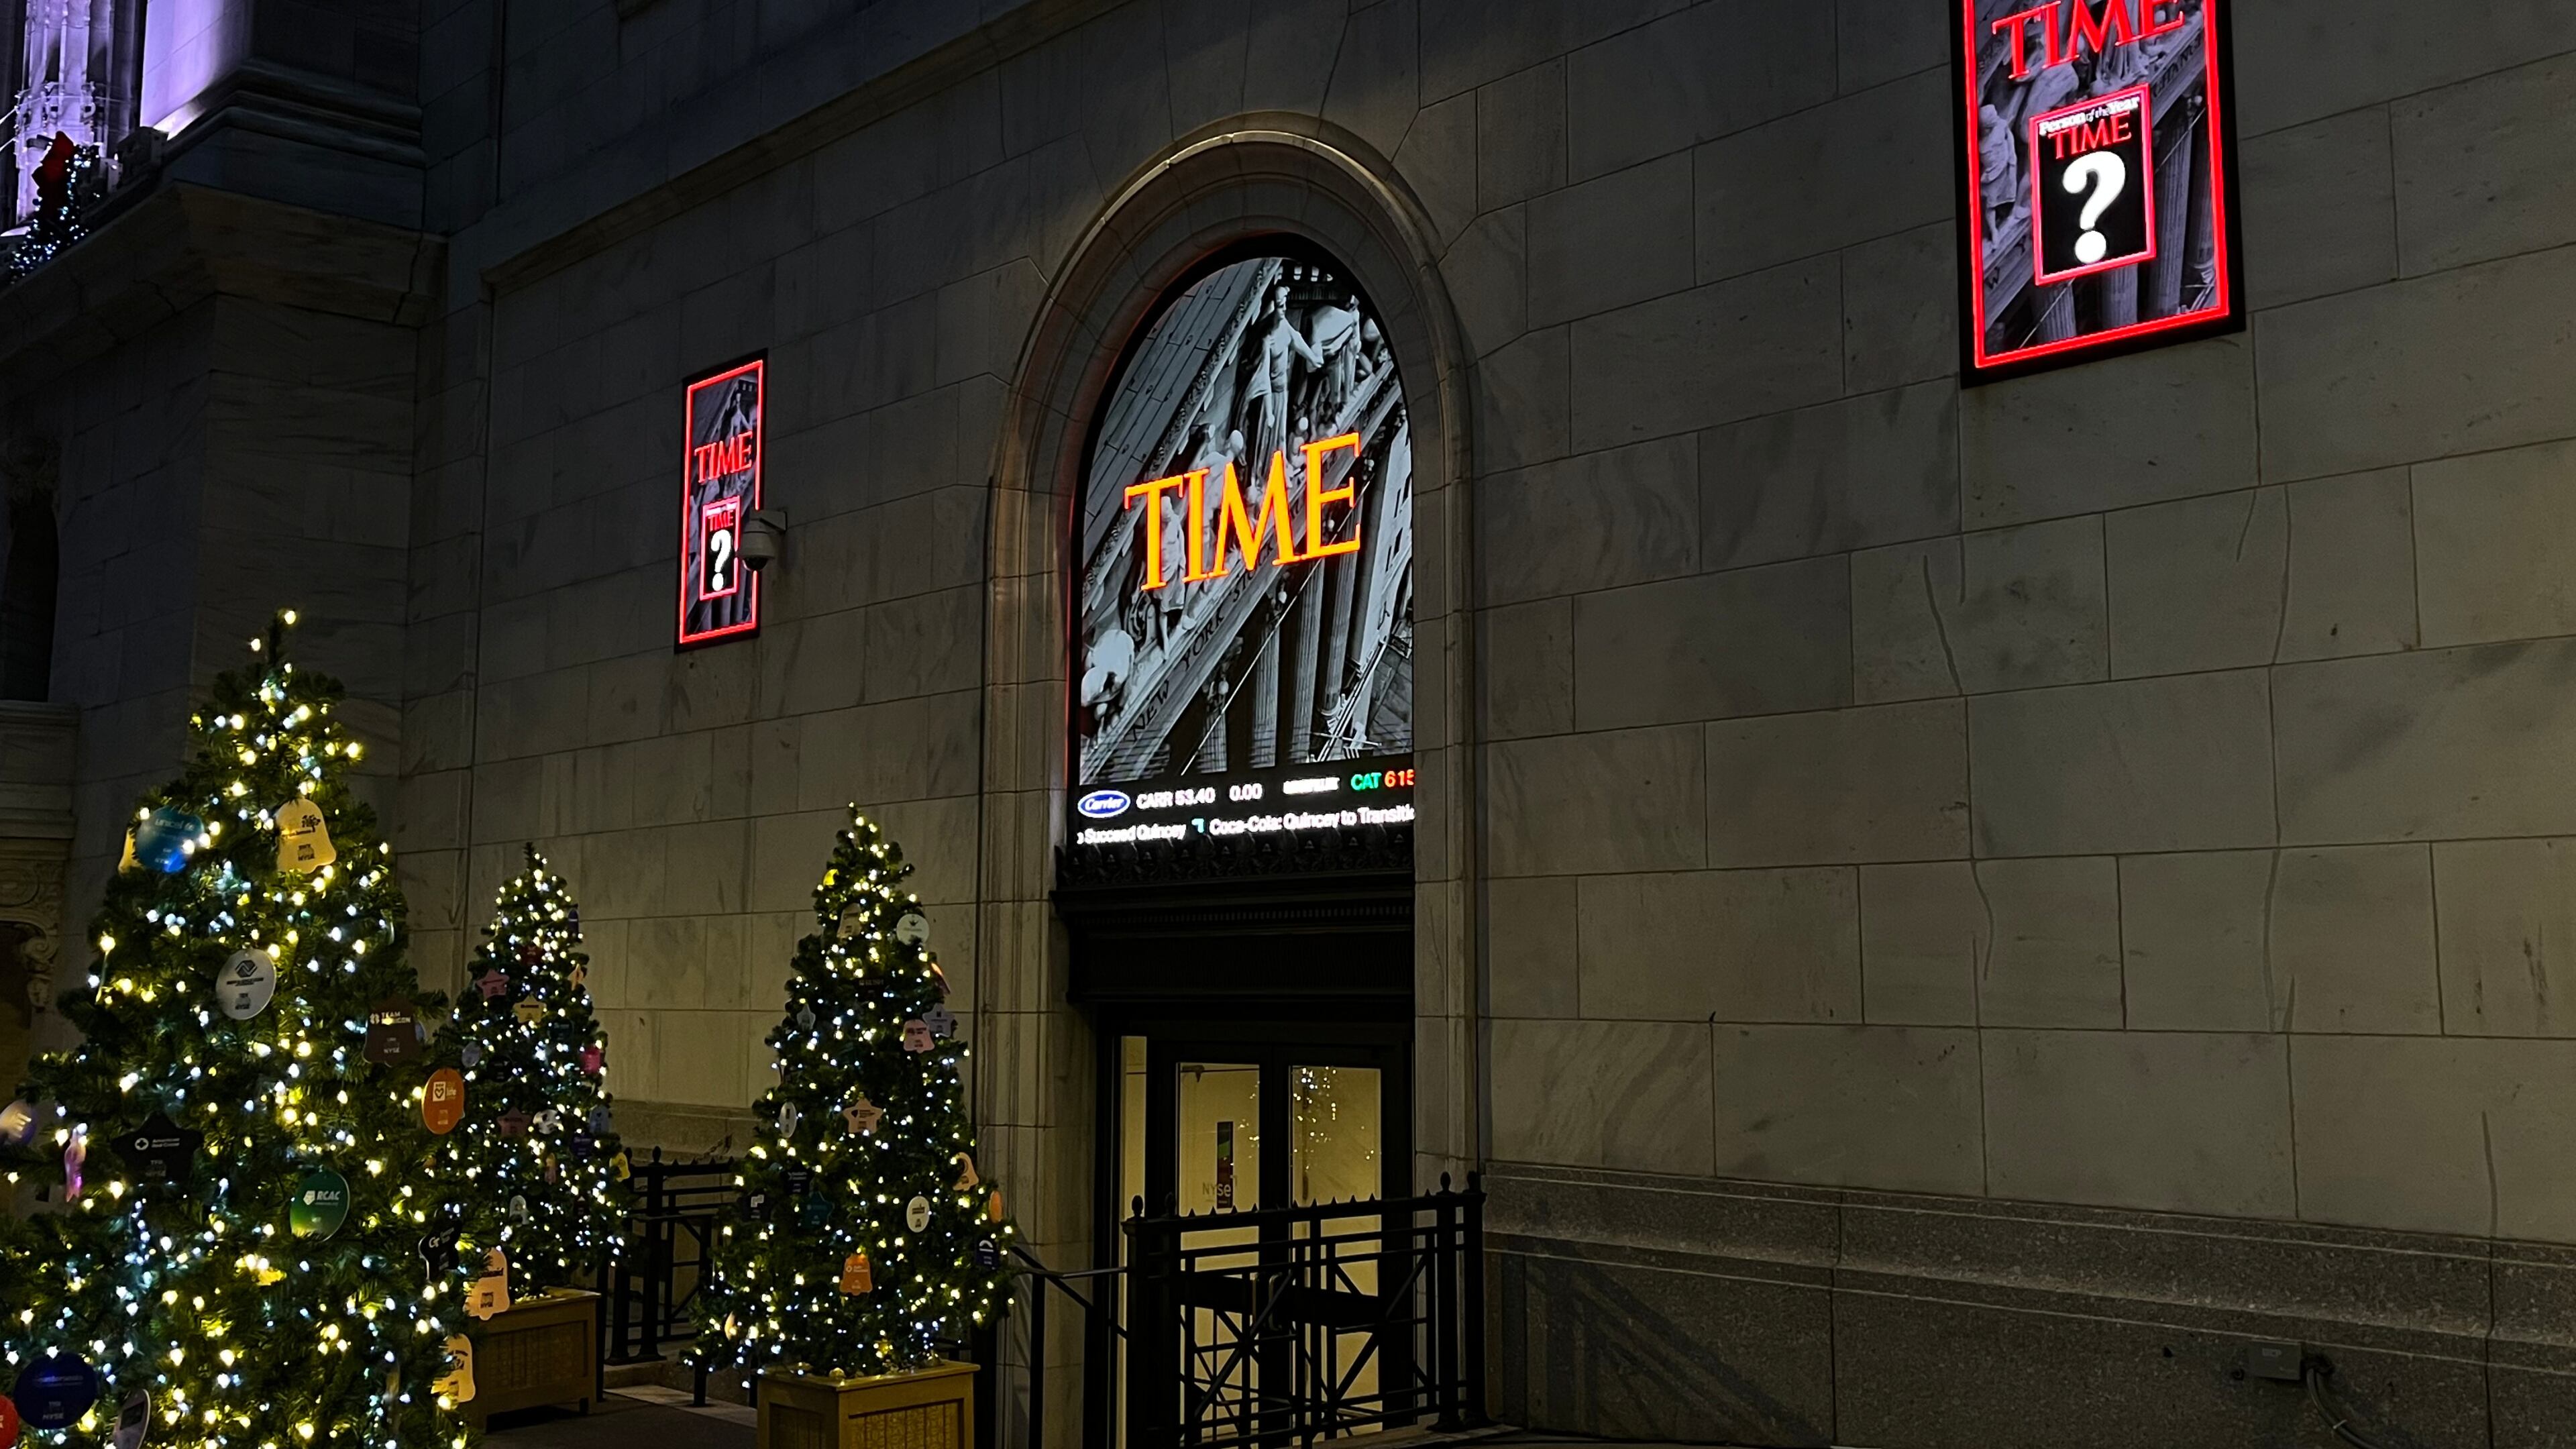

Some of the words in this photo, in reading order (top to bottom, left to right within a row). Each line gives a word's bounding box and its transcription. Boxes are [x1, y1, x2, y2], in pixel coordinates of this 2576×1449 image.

[2048, 110, 2132, 160] TIME
[694, 430, 753, 483] TIME
[708, 509, 734, 532] TIME
[1124, 431, 1361, 591] TIME
[1136, 791, 1173, 809] CARR
[1175, 787, 1216, 806] 53.40
[1229, 783, 1263, 802] 0.00
[1351, 772, 1382, 791] CAT
[1084, 825, 1137, 845] Succeed
[1136, 823, 1187, 841] Quincey
[1283, 812, 1340, 830] Quincey
[1340, 810, 1357, 826] to
[316, 1190, 341, 1201] RCAC
